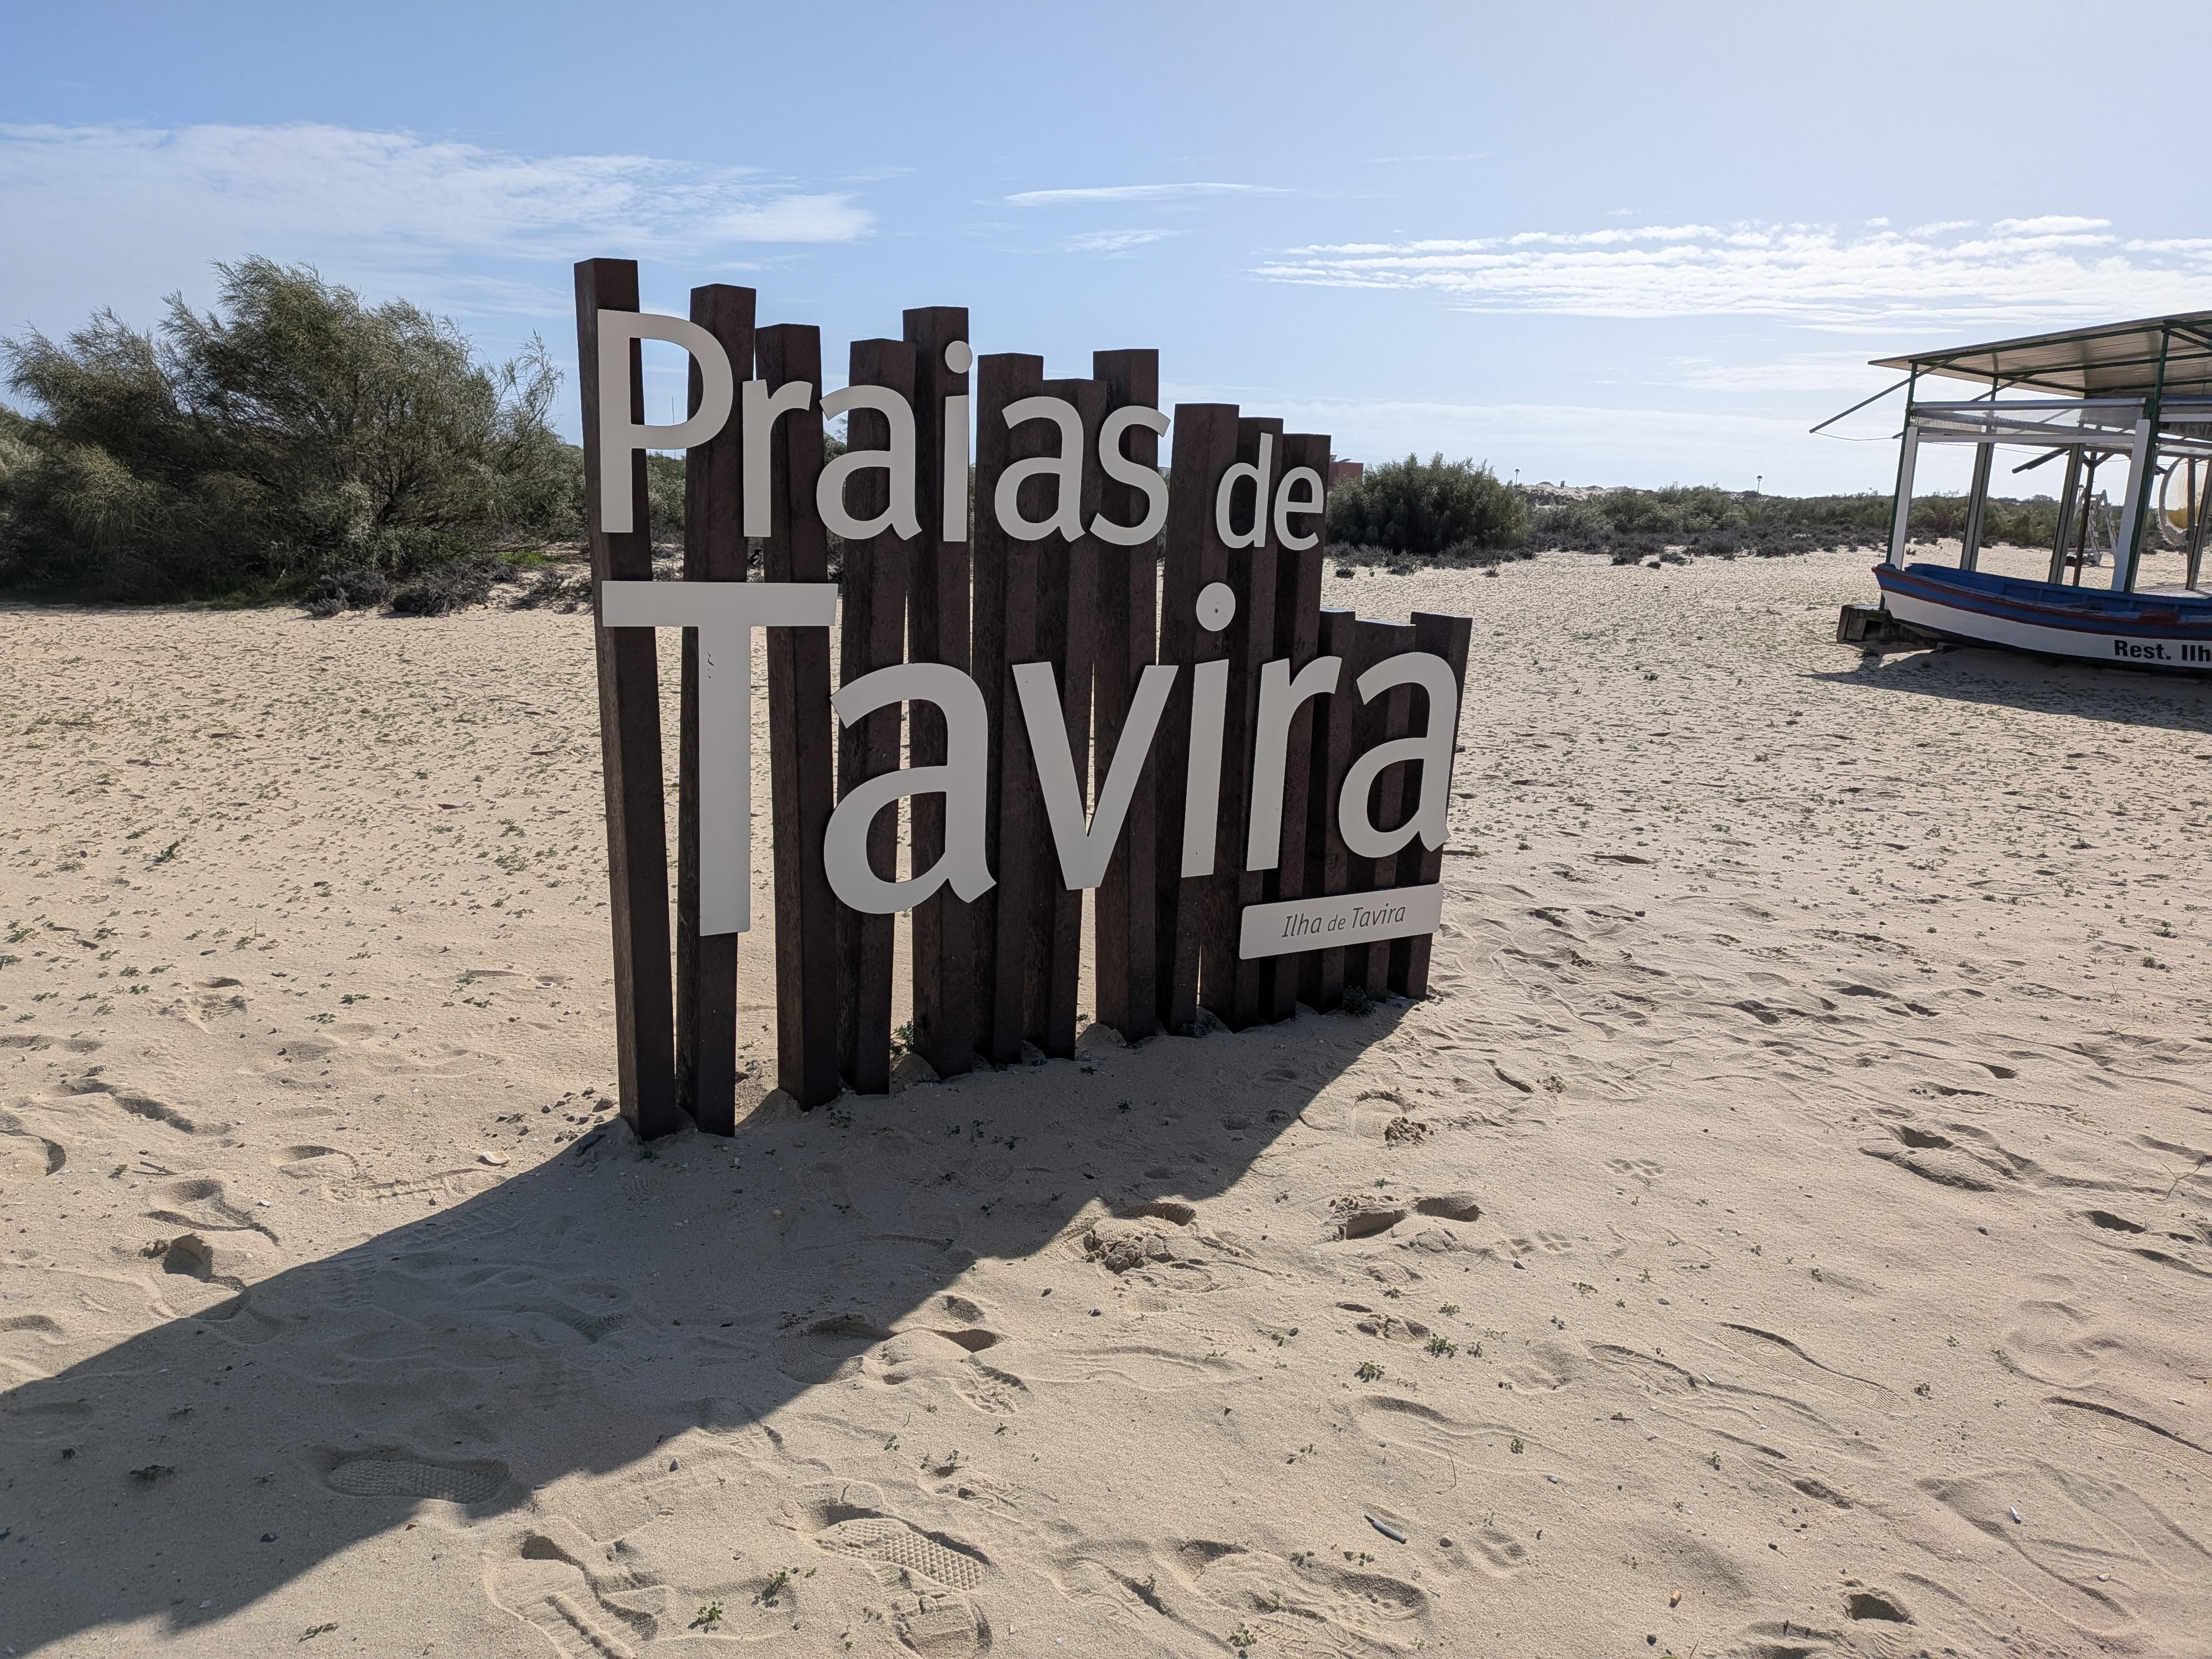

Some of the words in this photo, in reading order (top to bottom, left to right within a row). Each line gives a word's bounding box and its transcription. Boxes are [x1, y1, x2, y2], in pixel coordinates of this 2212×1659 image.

[598, 309, 1171, 546] Praias
[1216, 432, 1324, 551] de
[2114, 639, 2172, 660] Rest.
[601, 580, 1452, 936] Tavira
[1281, 913, 1322, 937] Ilha
[1327, 914, 1346, 932] de
[1352, 902, 1406, 928] Tavira
